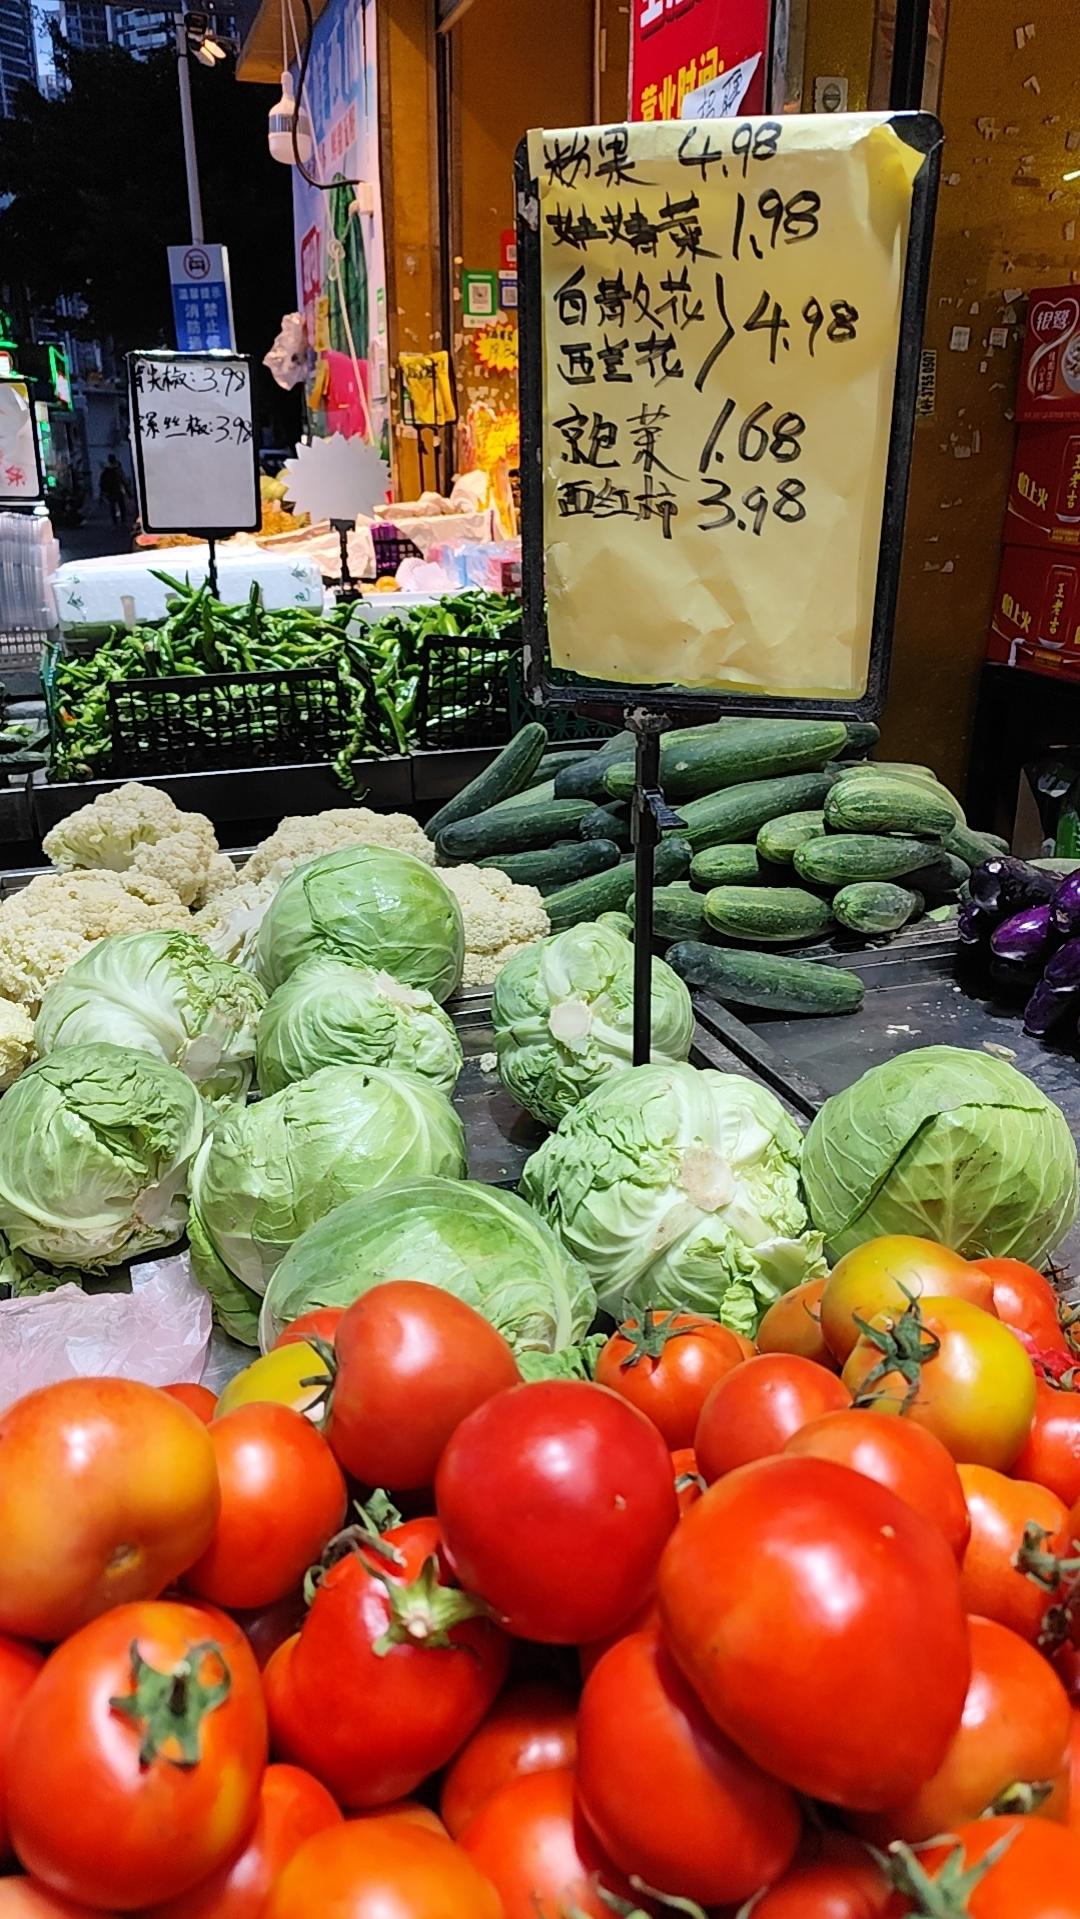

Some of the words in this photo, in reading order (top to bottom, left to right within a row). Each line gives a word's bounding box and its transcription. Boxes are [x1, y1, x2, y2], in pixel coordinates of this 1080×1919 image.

[679, 122, 782, 180] 4.98
[733, 189, 821, 260] 1.98
[743, 291, 860, 364] 4.98
[699, 398, 806, 473] 1.68
[557, 475, 678, 540] 西红柿
[698, 478, 806, 536] 3.98
